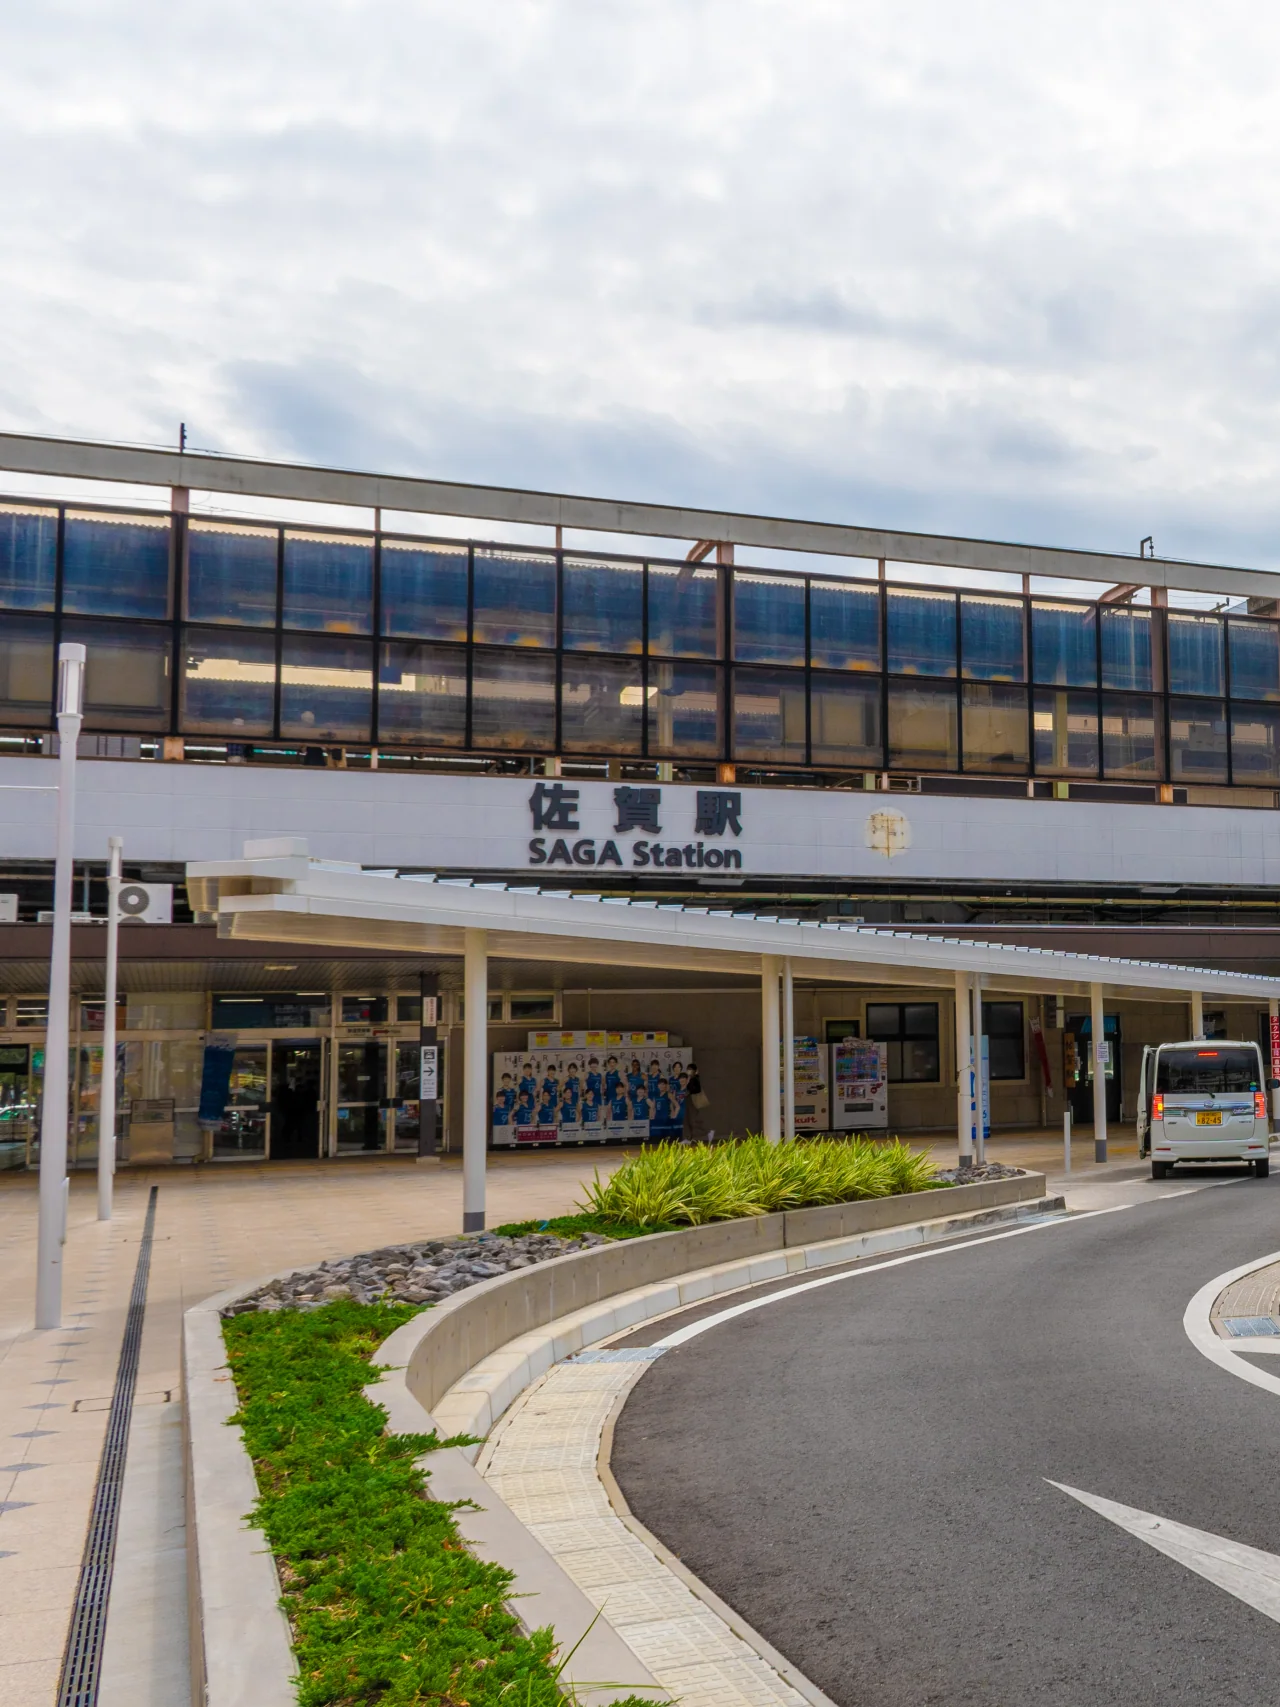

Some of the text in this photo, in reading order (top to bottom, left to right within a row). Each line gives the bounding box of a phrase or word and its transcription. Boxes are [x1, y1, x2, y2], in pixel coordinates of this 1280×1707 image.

[528, 782, 743, 837] 佐賀駅
[529, 837, 742, 869] SAGA Station
[504, 1053, 561, 1063] HEART
[608, 1050, 682, 1060] SPRINGS
[1201, 1117, 1222, 1125] 82-45
